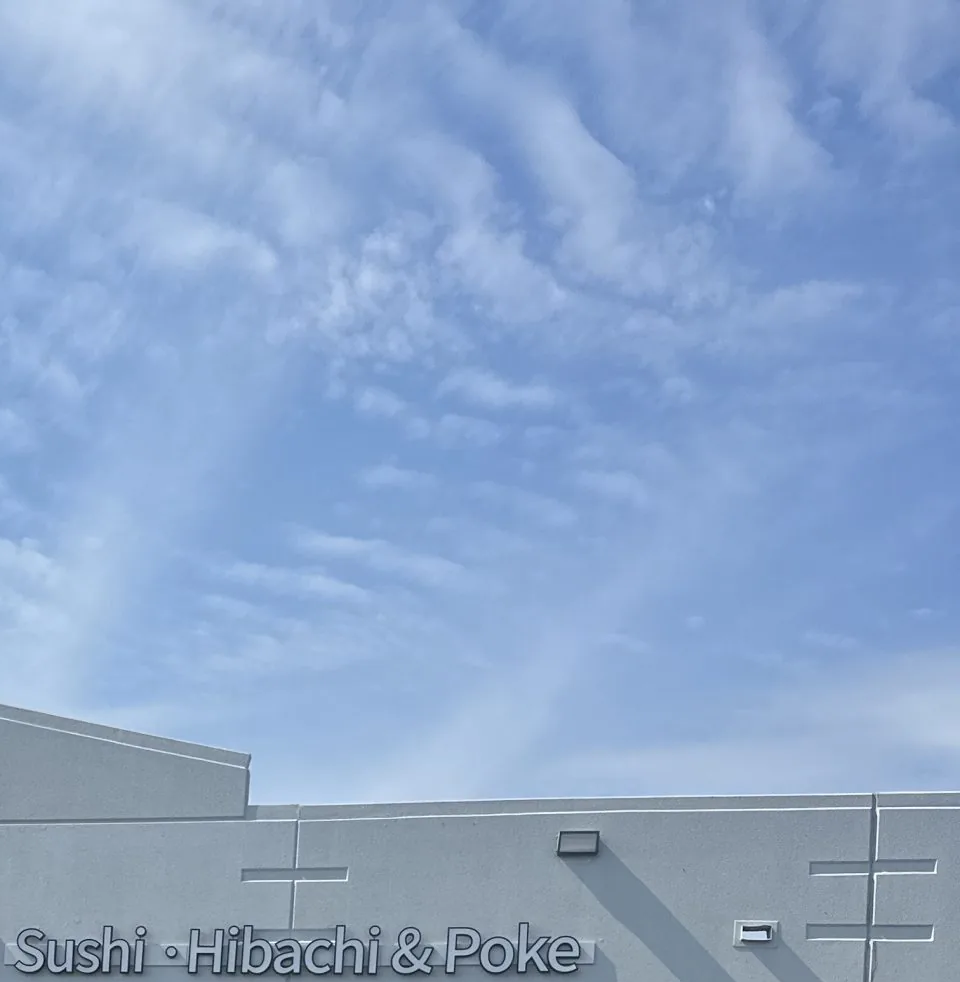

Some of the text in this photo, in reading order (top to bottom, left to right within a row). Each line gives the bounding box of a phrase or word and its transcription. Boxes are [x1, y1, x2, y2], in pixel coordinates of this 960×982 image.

[14, 925, 146, 975] Sushi
[187, 925, 380, 976] Hibachi
[390, 927, 434, 975] &
[444, 922, 582, 975] Poke
